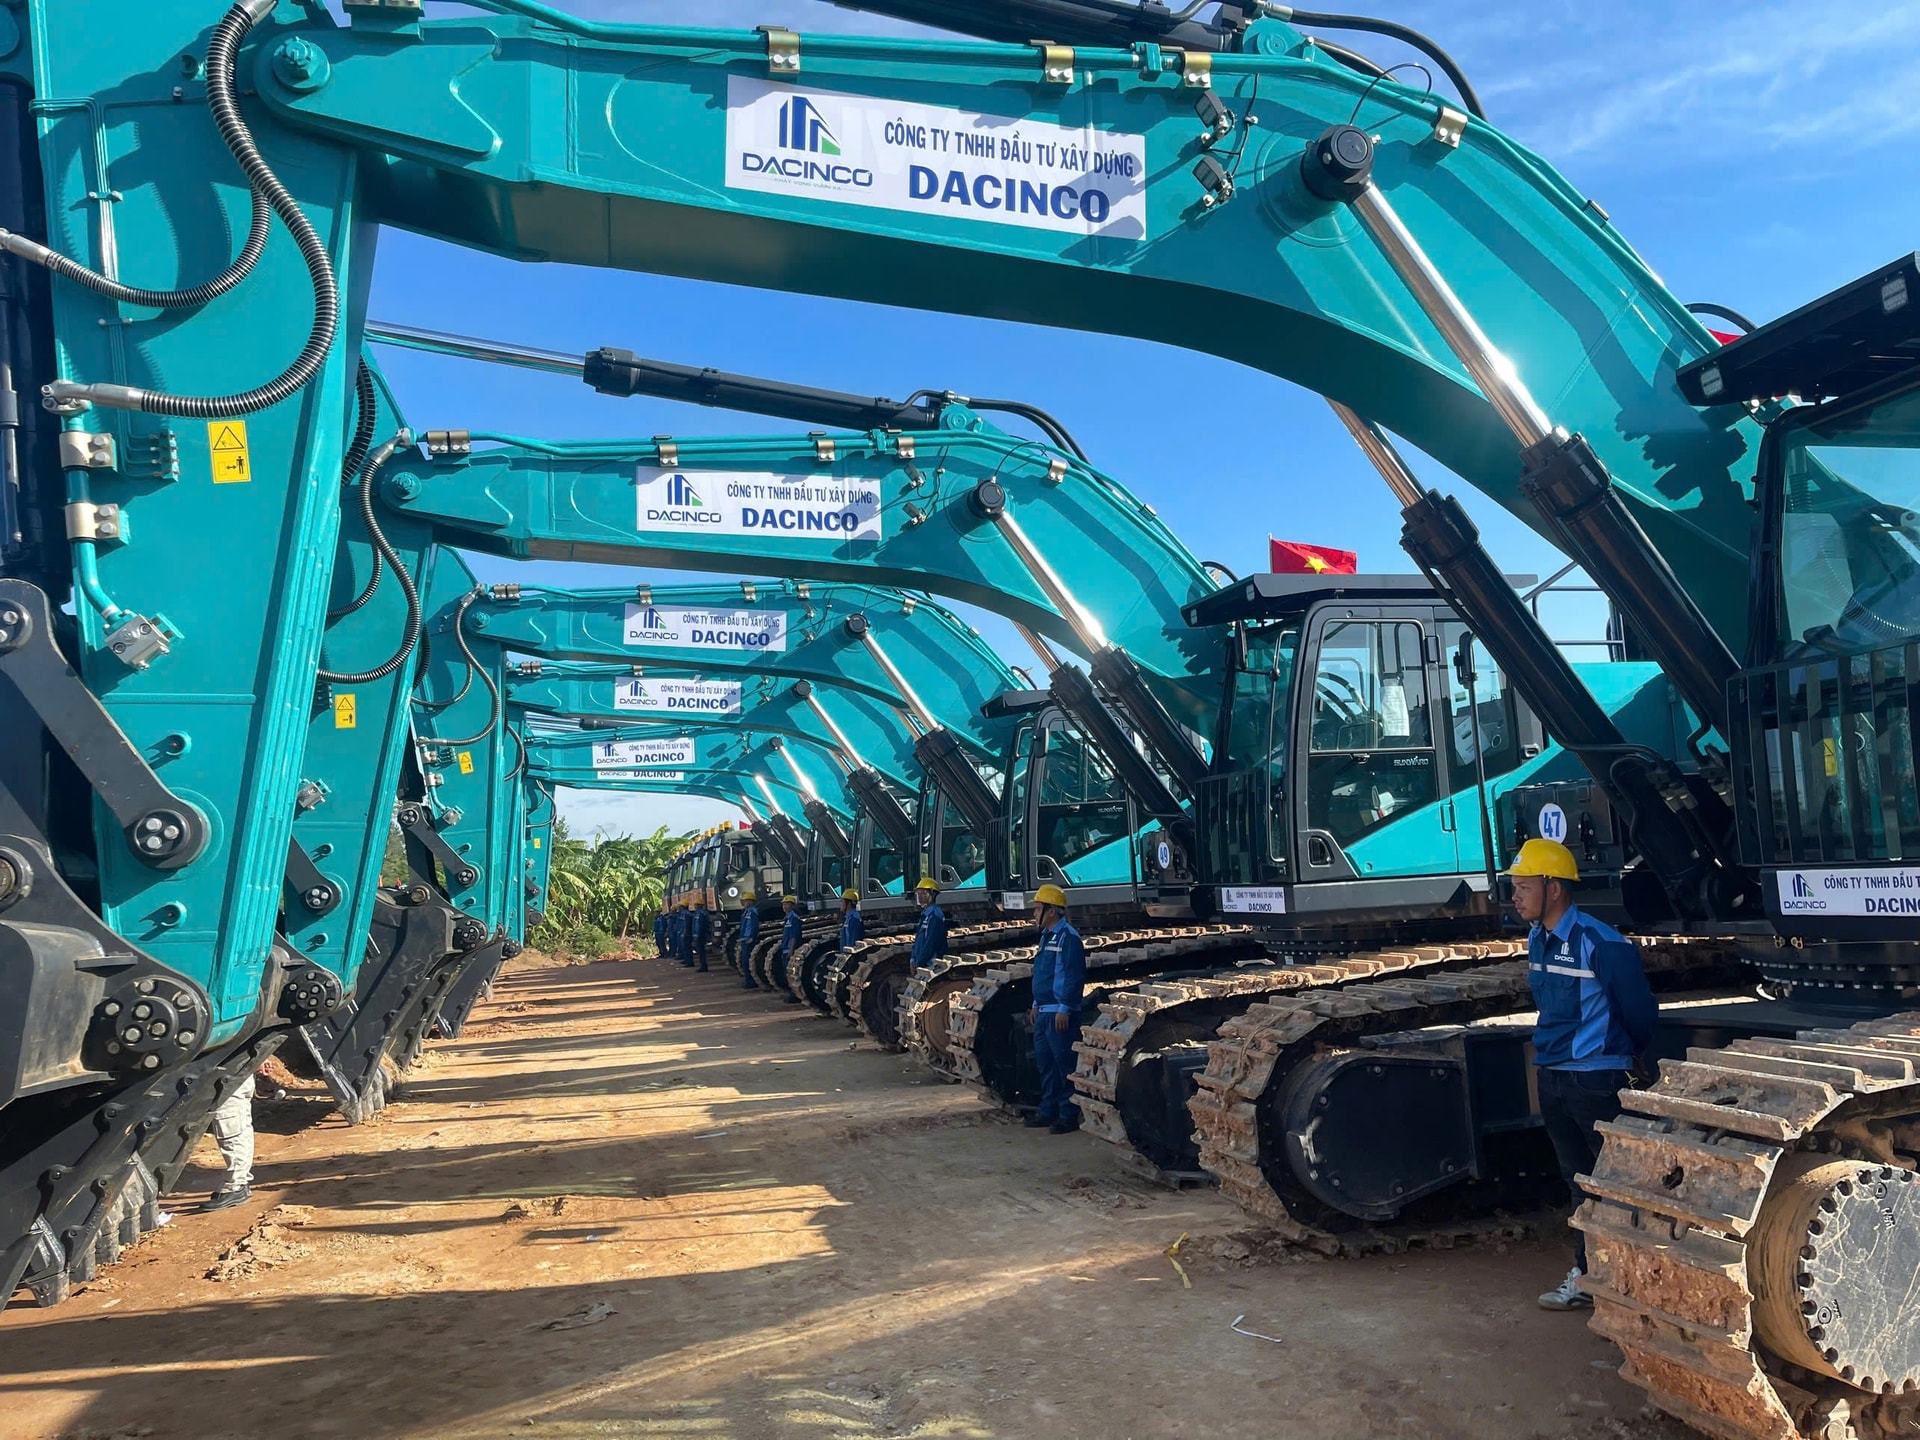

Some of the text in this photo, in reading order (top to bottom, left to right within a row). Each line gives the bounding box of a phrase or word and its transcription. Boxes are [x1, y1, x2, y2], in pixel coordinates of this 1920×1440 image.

[884, 117, 1134, 180] CÔNG TY TNHH ĐẦU TƯ XÂY DỰNG
[742, 152, 873, 187] DACINCO
[909, 164, 1110, 223] DACINCO
[727, 480, 872, 507] CÔNG TY TNHH ĐẦU TƯ XÂY DỰNG
[647, 509, 722, 523] DACINCO
[742, 507, 859, 532] DACINCO
[683, 613, 700, 624] CÔNG
[701, 615, 709, 625] TY
[630, 630, 679, 640] DACINCO
[692, 629, 770, 646] DACINCO
[667, 697, 729, 709] DACINCO
[635, 752, 685, 763] DACINCO
[633, 770, 677, 778] DACINCO
[1543, 811, 1561, 838] 47
[1159, 846, 1168, 863] 49
[1824, 874, 1849, 889] CÔNG
[1850, 876, 1862, 889] TY
[1864, 876, 1890, 889] TNHH
[1783, 900, 1827, 909] DACINCO
[1864, 897, 1920, 913] DACIN
